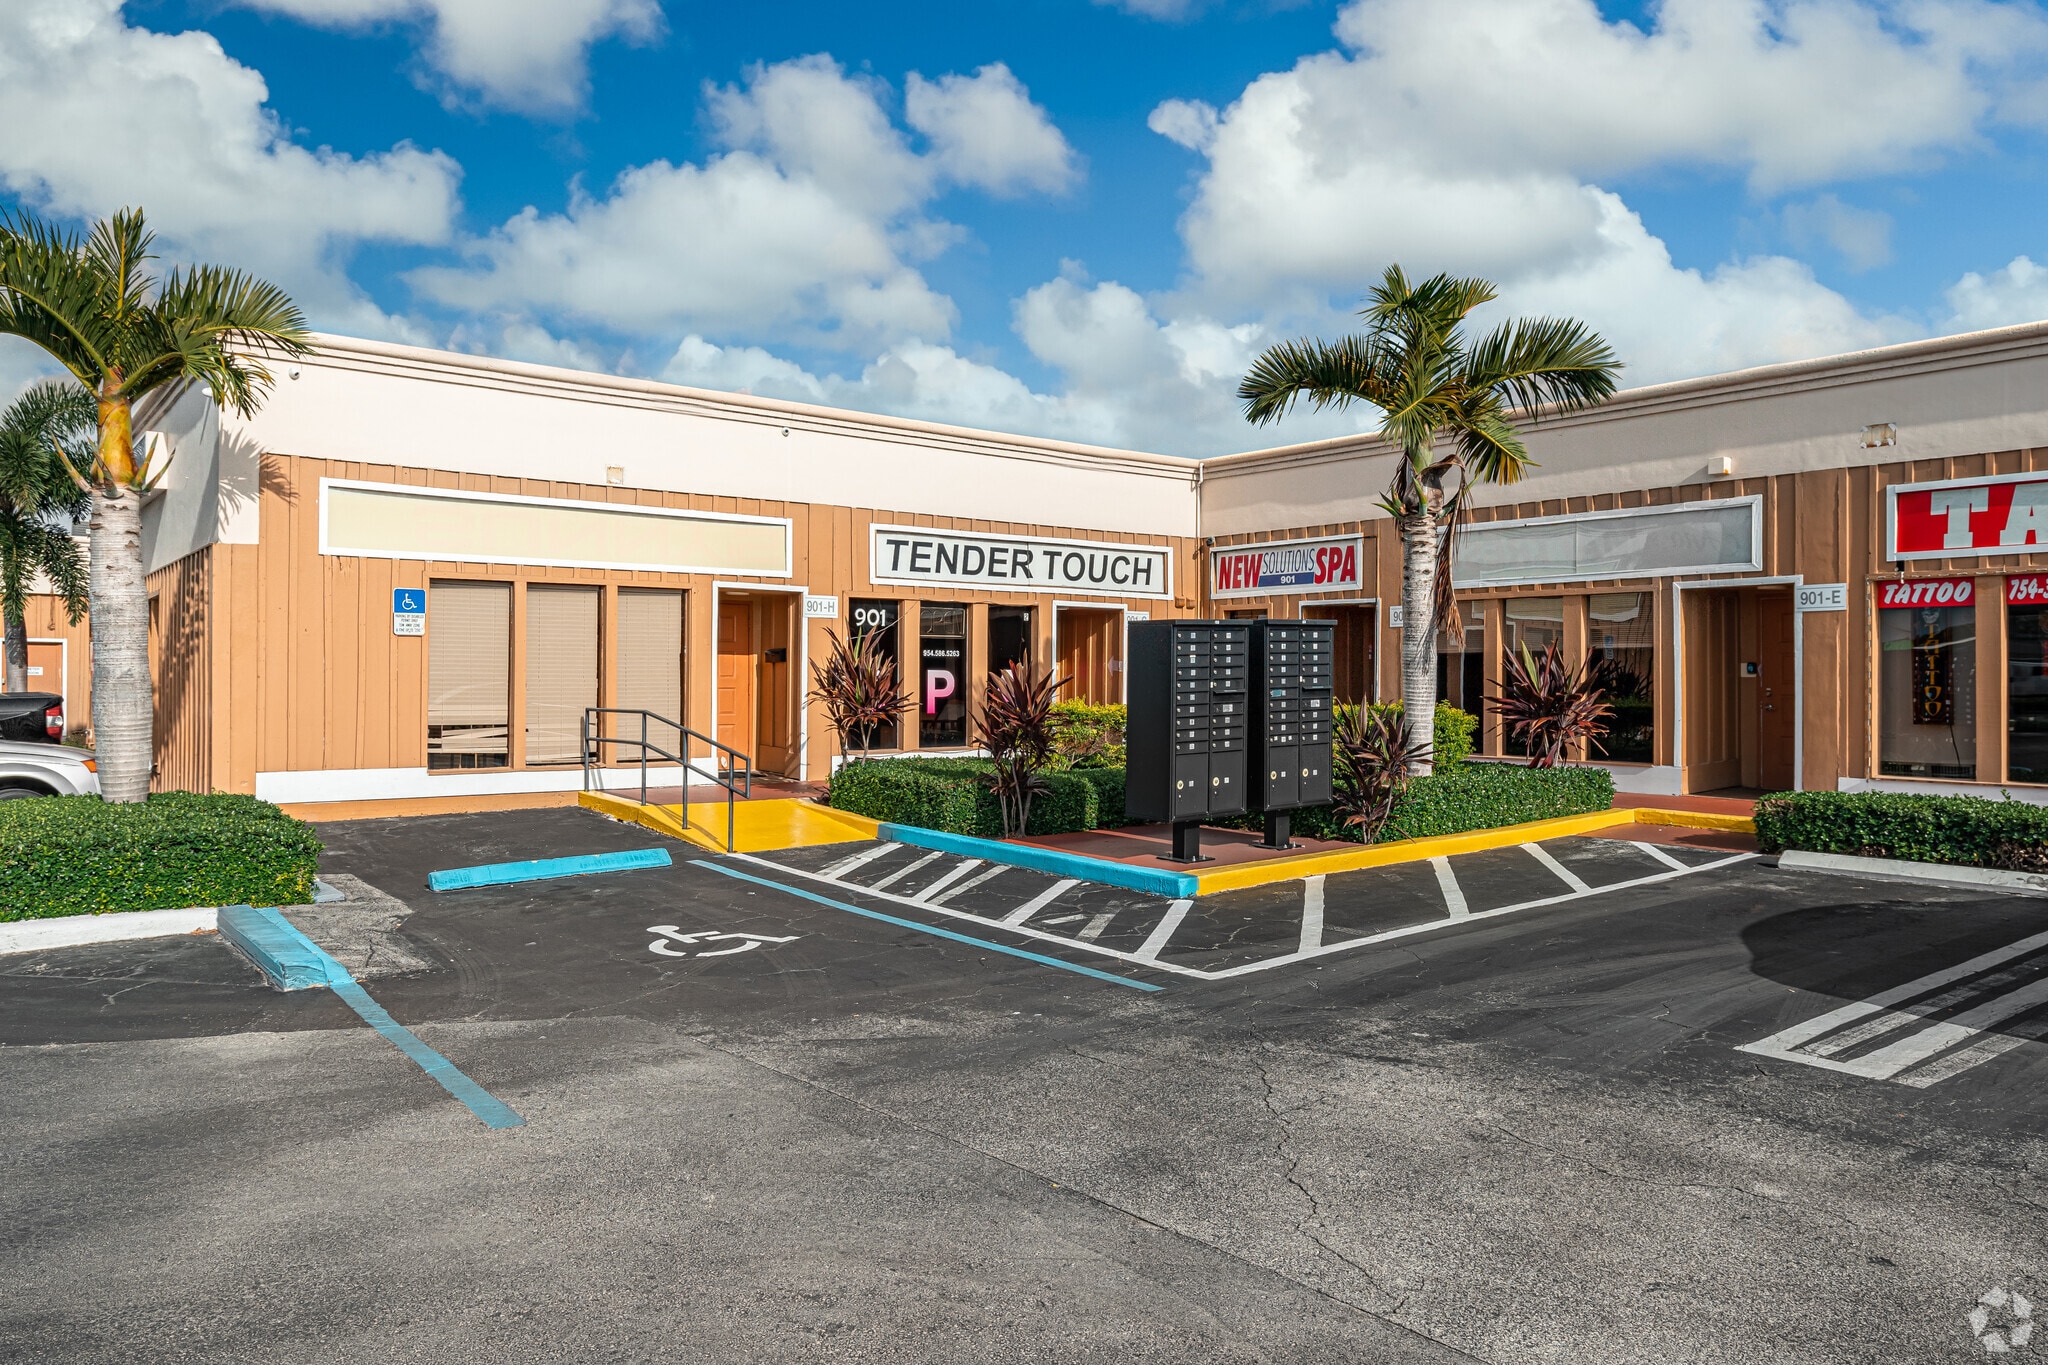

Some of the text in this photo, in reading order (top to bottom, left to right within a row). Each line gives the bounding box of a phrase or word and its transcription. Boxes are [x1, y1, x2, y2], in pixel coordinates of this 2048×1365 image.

[1930, 483, 2048, 549] TA
[885, 538, 1153, 586] TENDER TOUCH
[1218, 545, 1357, 590] NEW SOLUTIONS SPA
[1280, 575, 1296, 584] 901
[1884, 581, 1972, 604] TATTOO
[806, 600, 835, 613] 901-H
[1800, 590, 1841, 605] 901-E
[854, 608, 886, 628] 901
[1924, 623, 1942, 717] TATTOO
[926, 669, 955, 714] P
